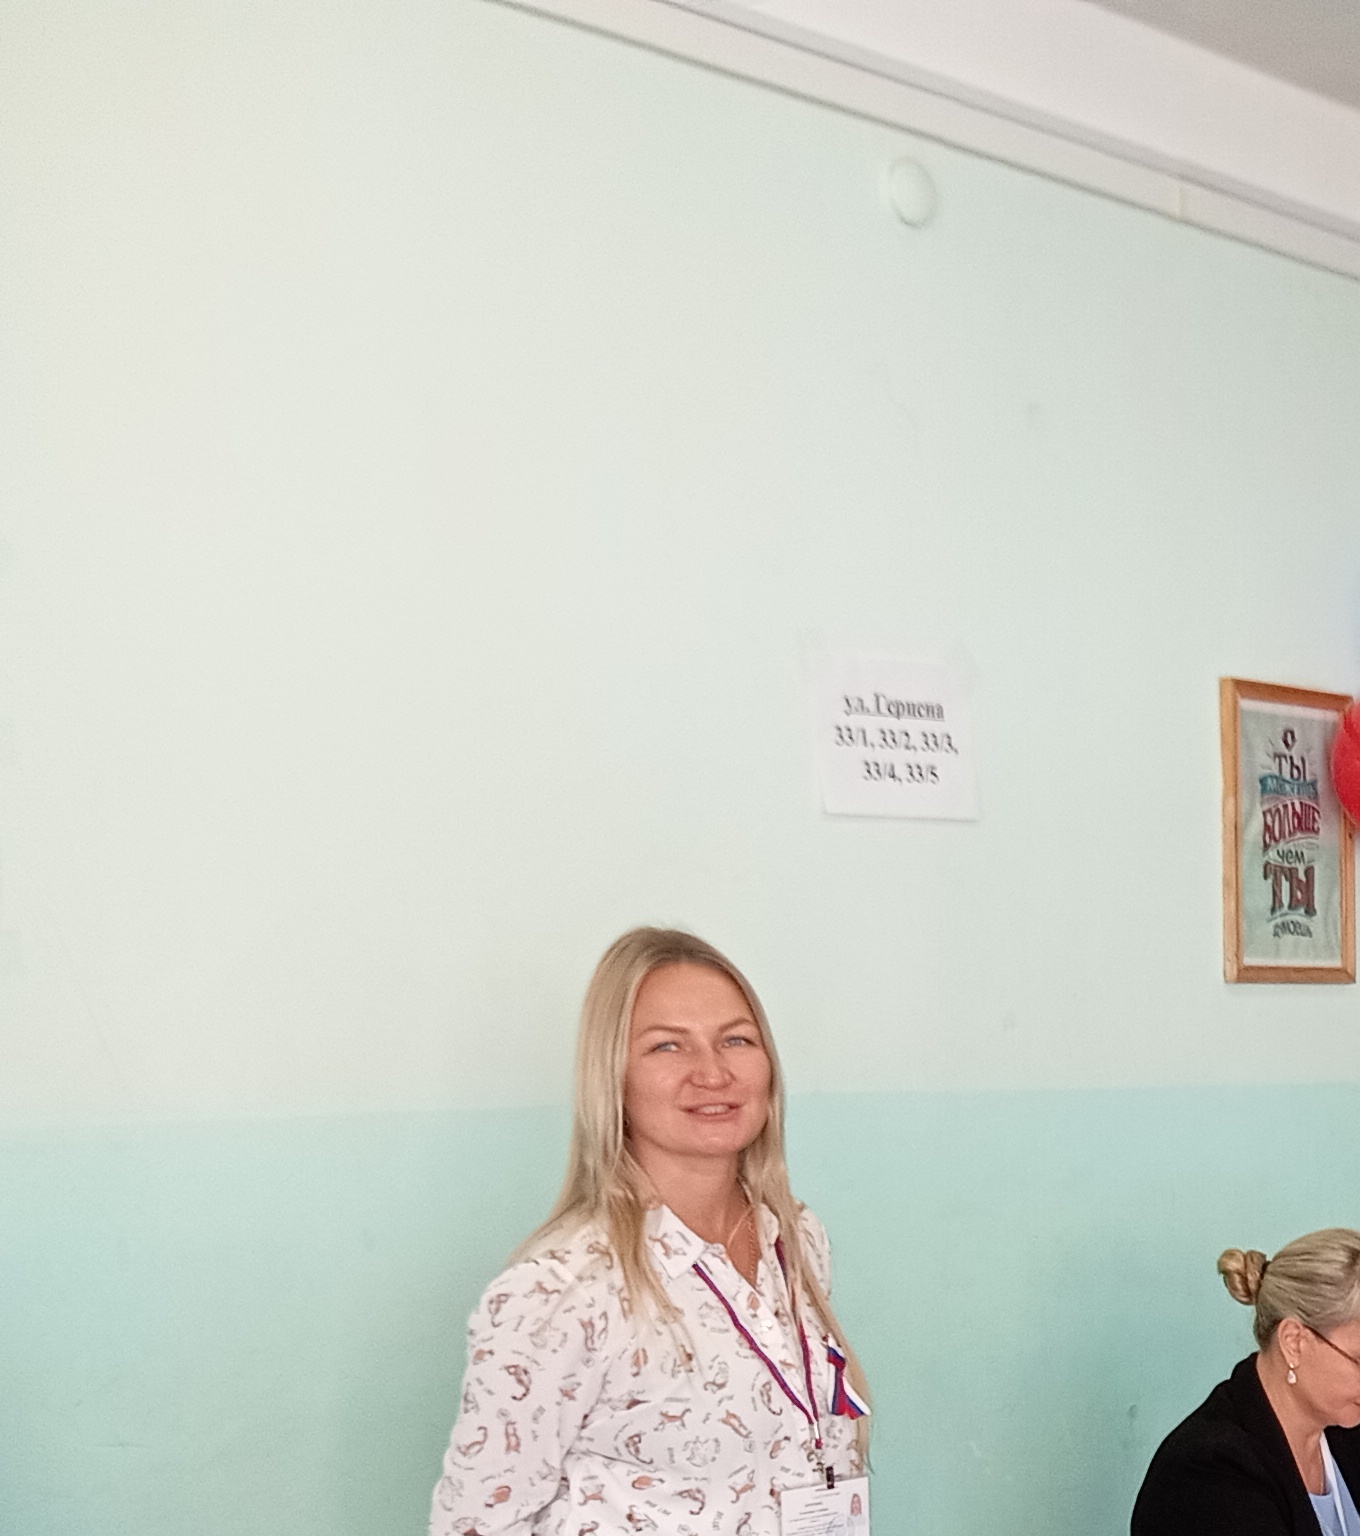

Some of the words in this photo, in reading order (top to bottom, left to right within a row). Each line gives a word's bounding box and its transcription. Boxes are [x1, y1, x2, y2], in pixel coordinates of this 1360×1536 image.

[843, 694, 870, 717] ул.
[873, 692, 945, 720] Герцена
[834, 725, 875, 750] 33/1,
[879, 728, 918, 753] 33/2,
[920, 730, 959, 755] 33/3,
[862, 760, 903, 785] 33/4,
[905, 763, 940, 785] 33/5
[1273, 751, 1307, 782] ТЫ
[1262, 800, 1321, 853] БОЛЬШЕ
[1263, 861, 1317, 917] ТЫ
